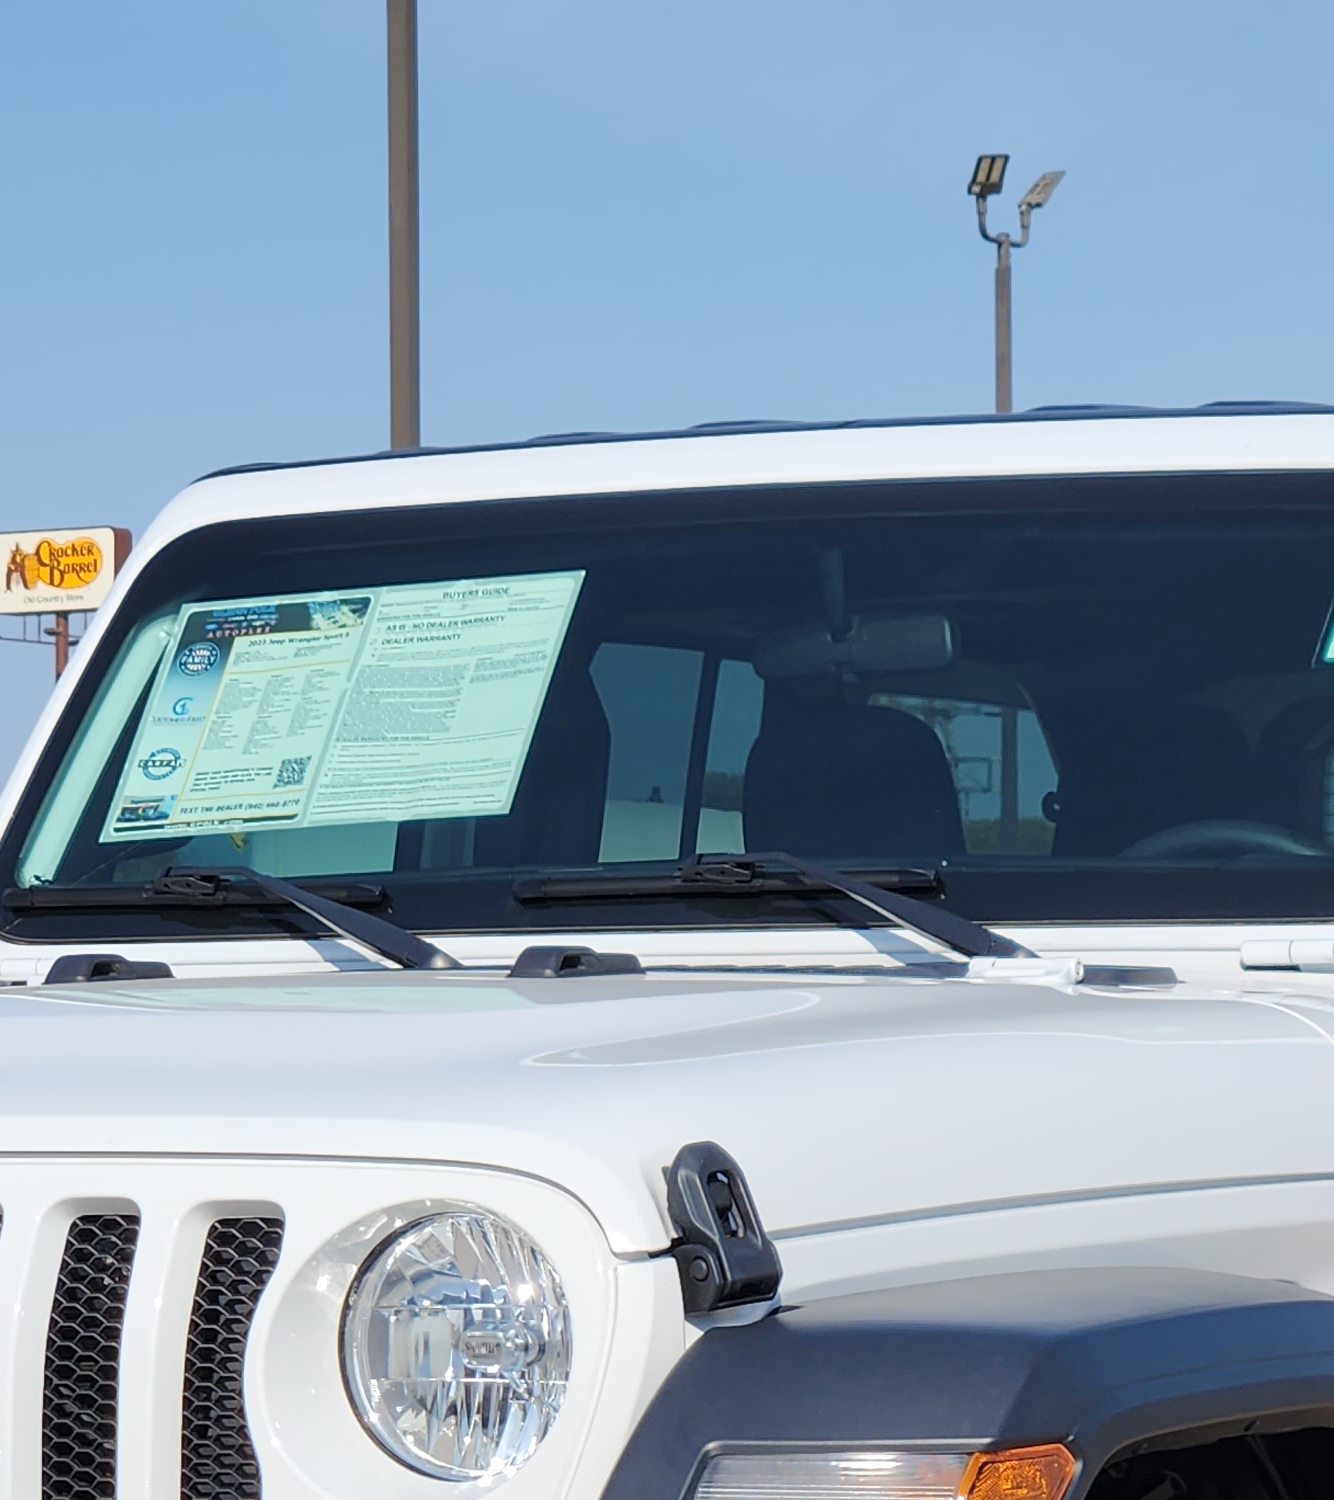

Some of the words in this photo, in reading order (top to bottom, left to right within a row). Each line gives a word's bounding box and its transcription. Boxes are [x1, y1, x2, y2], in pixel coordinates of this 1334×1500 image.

[35, 540, 95, 567] Cracker
[49, 558, 98, 588] Barrel
[23, 595, 36, 604] Old
[37, 594, 64, 604] Country
[65, 593, 85, 602] Store
[442, 589, 478, 600] BUYERS
[481, 587, 511, 597] GUIDE
[386, 624, 397, 632] AS
[412, 622, 425, 630] NO
[425, 619, 459, 629] DEALER
[460, 615, 507, 627] WARRANTY
[206, 626, 271, 639] AUTOPLEX
[269, 638, 285, 646] Jeep
[288, 635, 321, 645] Wrangler
[324, 633, 343, 643] Sport
[381, 637, 414, 646] DEALER
[416, 633, 462, 644] WARRANTY
[181, 655, 216, 664] FAMILY
[180, 806, 199, 814] TEXT
[216, 803, 243, 812] DEALER
